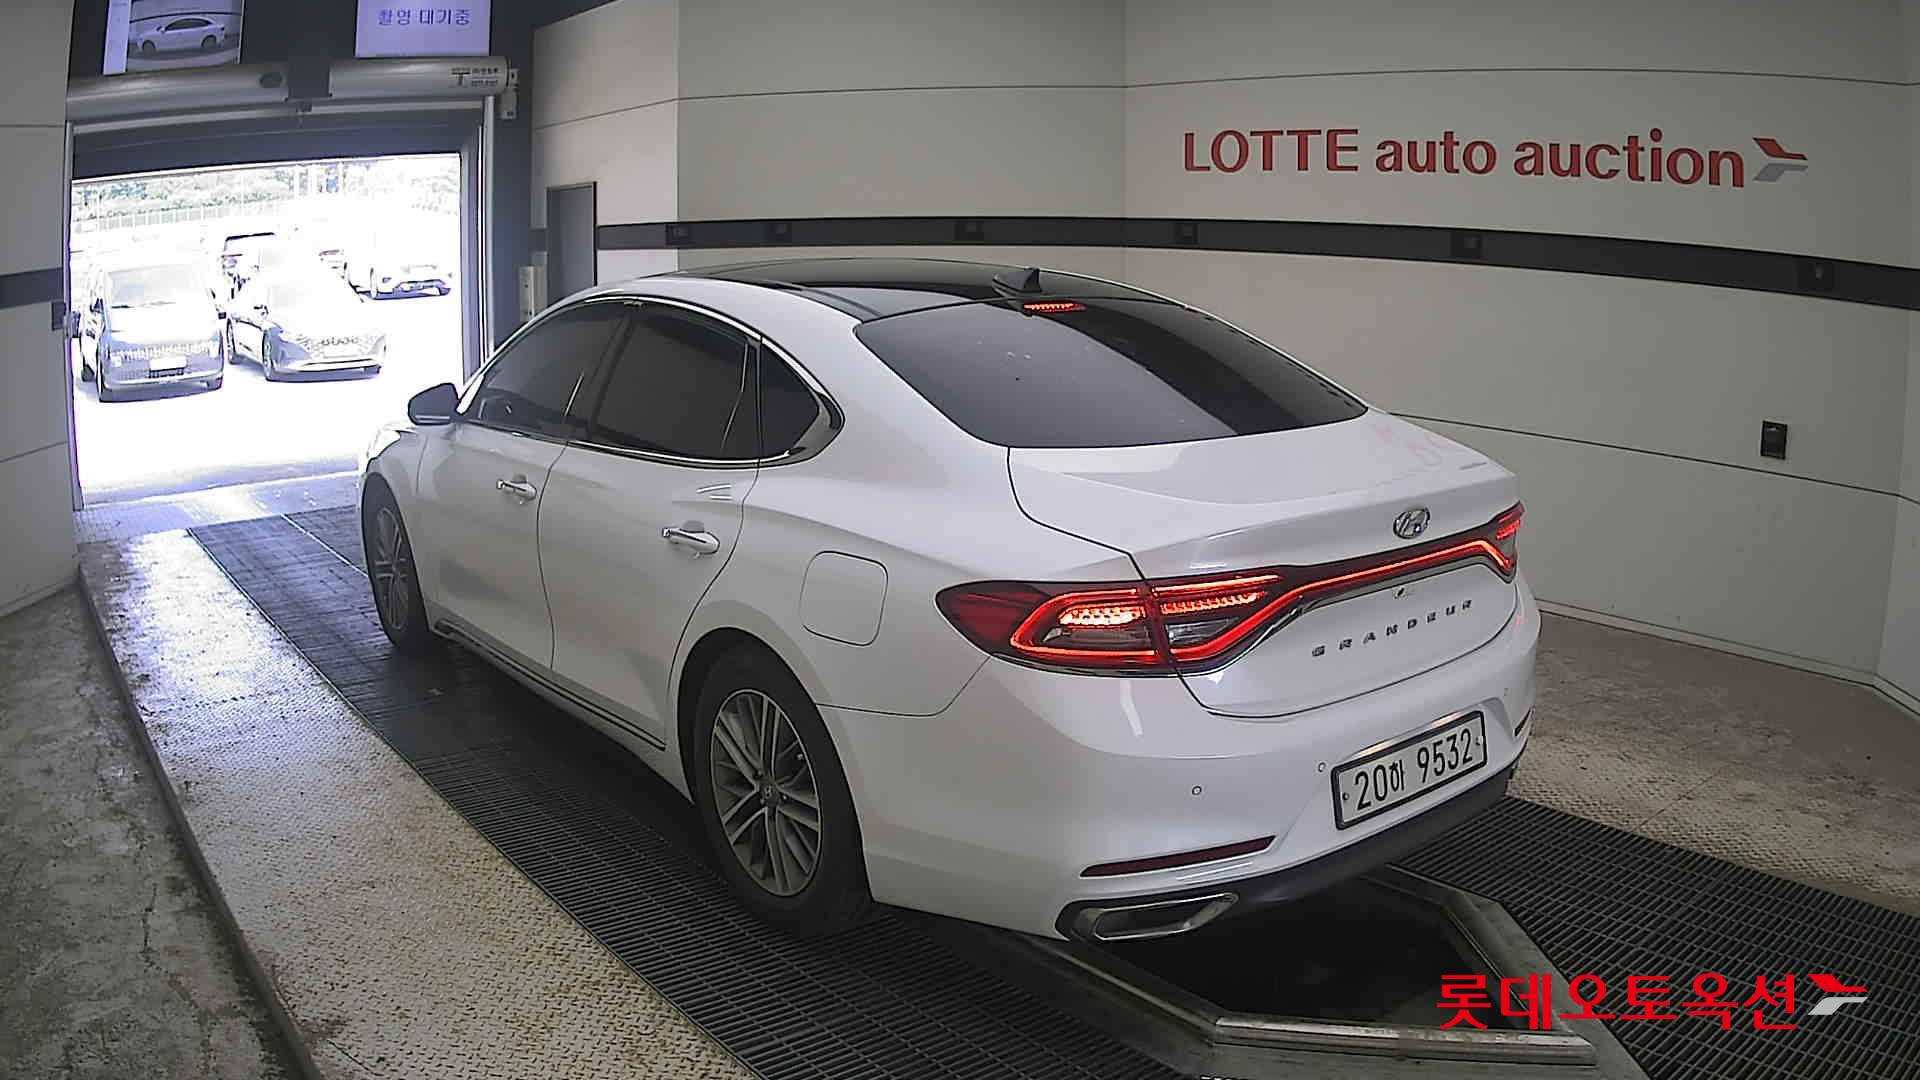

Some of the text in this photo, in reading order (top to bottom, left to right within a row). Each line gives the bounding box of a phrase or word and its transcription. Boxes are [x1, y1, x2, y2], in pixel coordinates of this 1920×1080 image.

[419, 8, 471, 26] 대기중
[1184, 127, 1746, 188] LOTTE auto auction
[1311, 599, 1473, 657] GRANDEUR
[1353, 727, 1473, 811] 20하 9532
